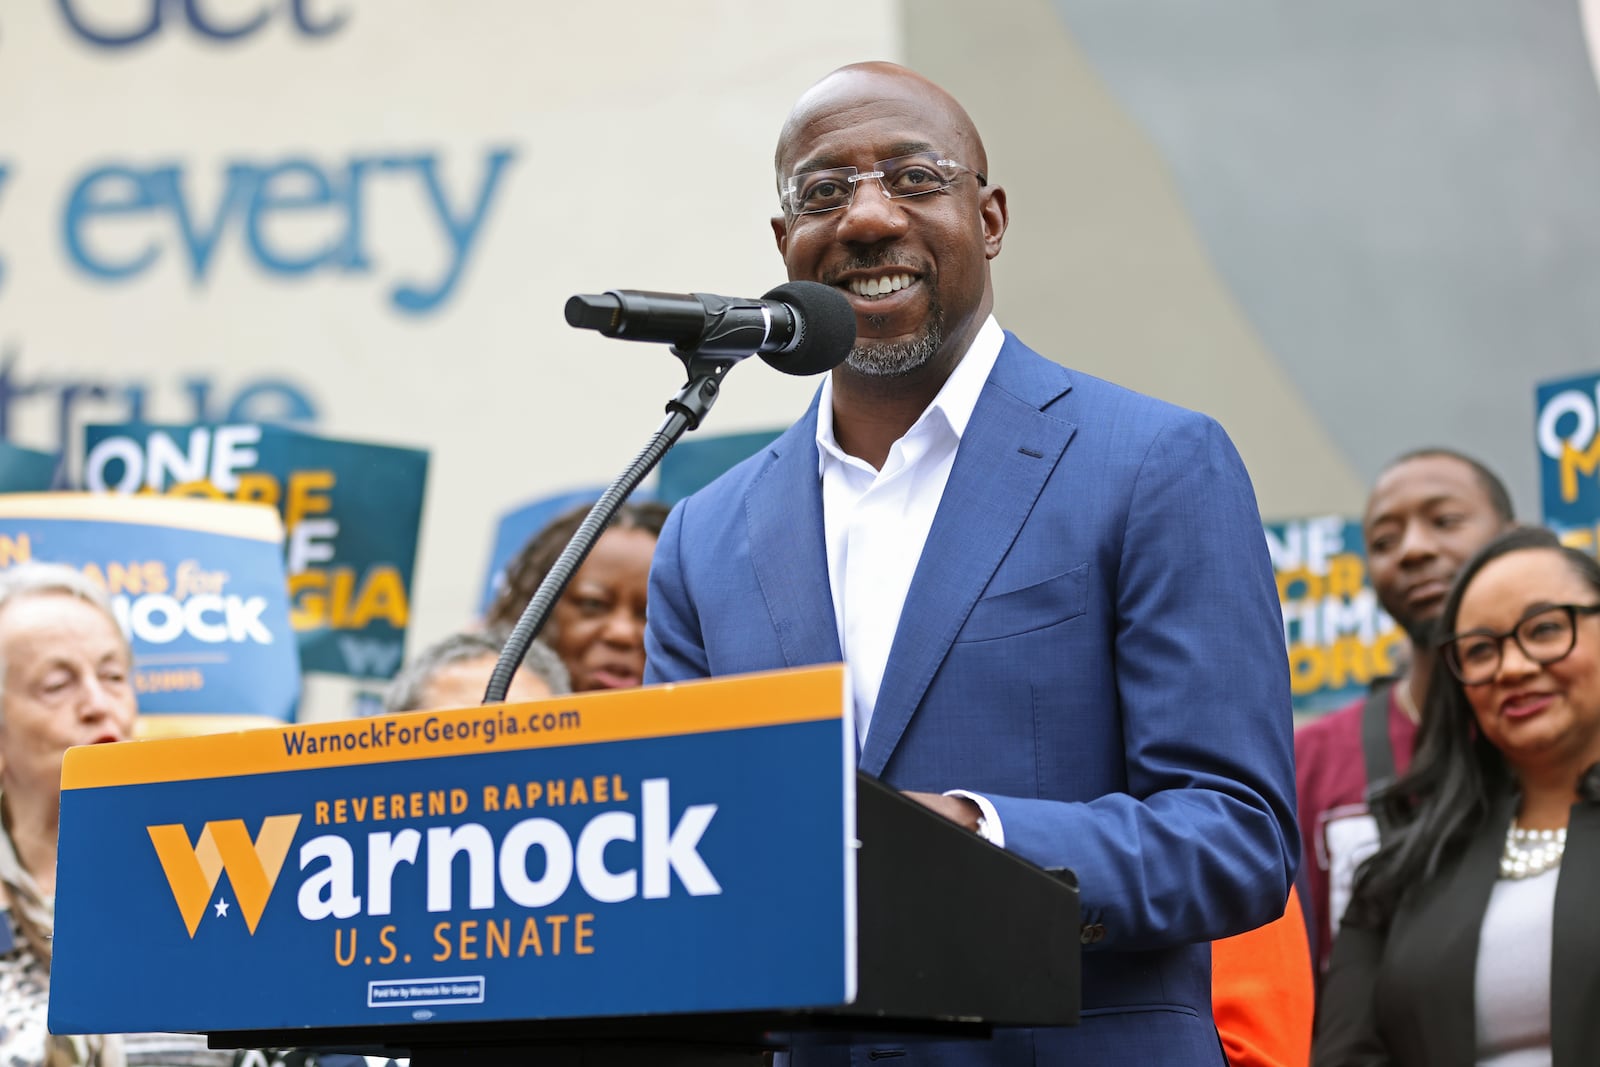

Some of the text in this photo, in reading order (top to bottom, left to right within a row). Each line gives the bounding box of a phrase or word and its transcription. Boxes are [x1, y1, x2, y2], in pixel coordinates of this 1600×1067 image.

[61, 146, 518, 317] every
[85, 424, 261, 497] ONE
[174, 559, 229, 600] for
[283, 710, 581, 757] WarnockForGeorgia.com
[315, 776, 628, 825] REVEREND RAPHAEL
[147, 778, 721, 938] Warnock
[335, 914, 594, 967] U.S. SENATE
